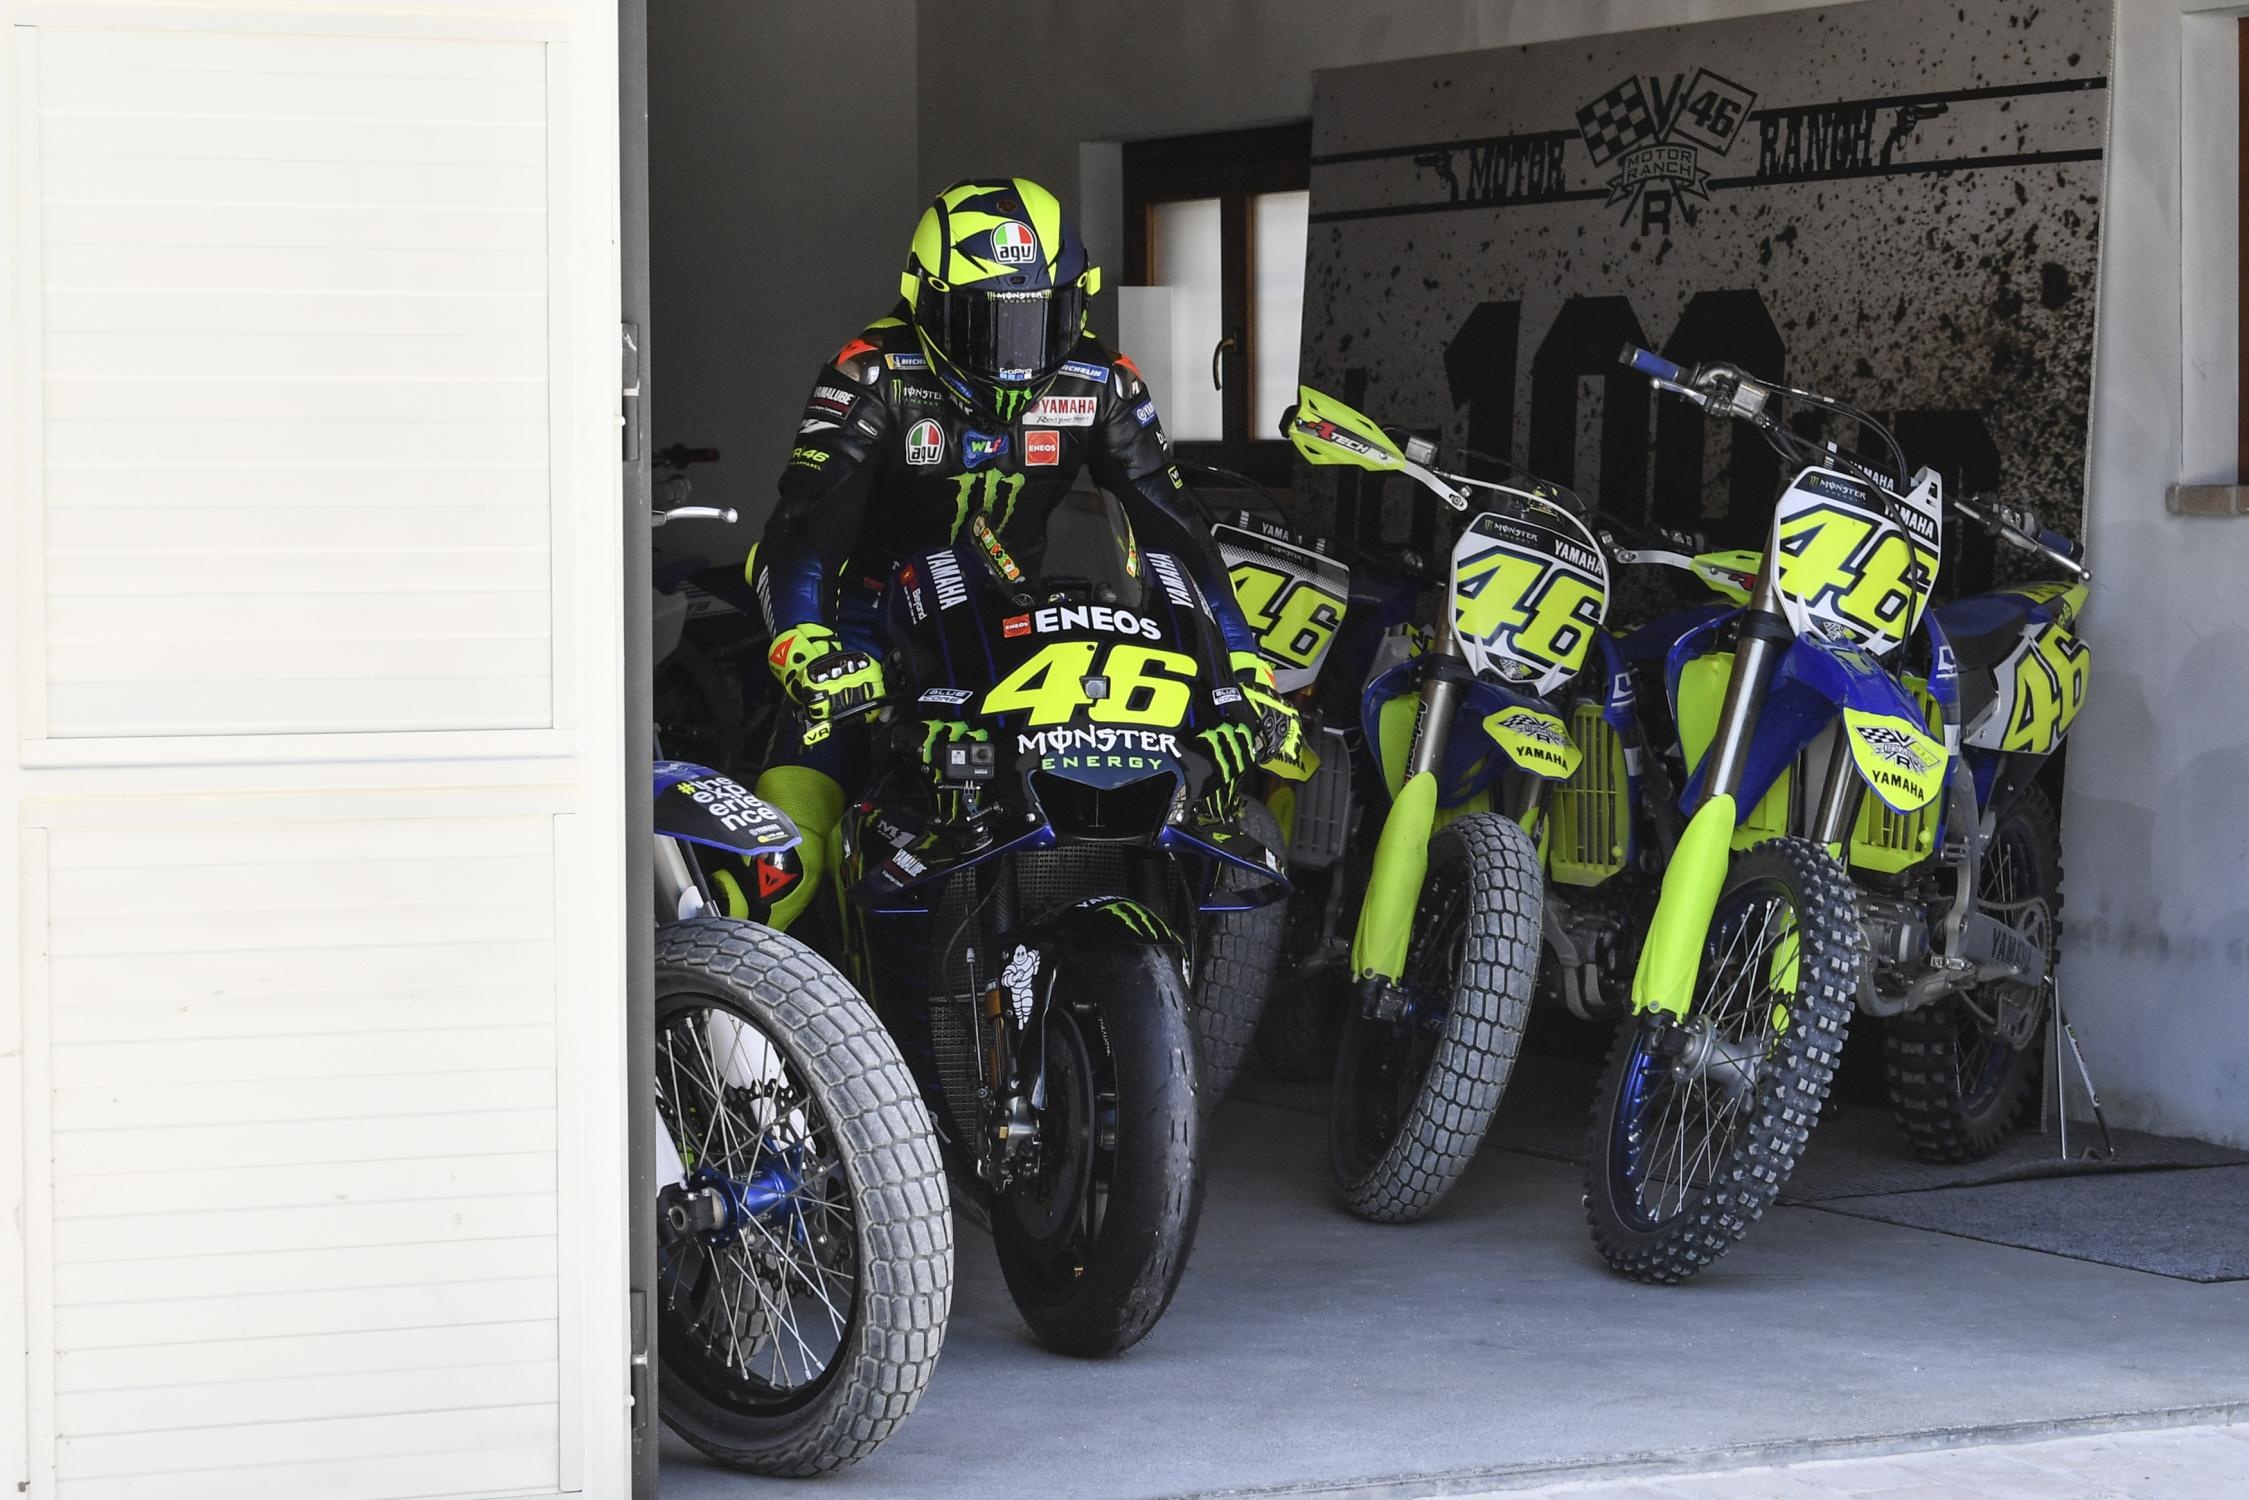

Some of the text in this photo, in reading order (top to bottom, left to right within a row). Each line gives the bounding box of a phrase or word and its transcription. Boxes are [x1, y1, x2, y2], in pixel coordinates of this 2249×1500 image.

[1687, 90, 1742, 138] 46
[1757, 107, 1876, 175] RANCH
[1466, 142, 1566, 200] MOTOR
[1627, 149, 1692, 168] MOTOR
[1627, 162, 1692, 181] RANCH
[1060, 364, 1103, 378] ICHELIN
[1042, 399, 1095, 414] YAMAHA
[1028, 444, 1057, 453] ENEOS
[1820, 479, 1867, 500] MONSTER
[1494, 523, 1539, 541] MONSTER
[926, 550, 968, 611] YAMAHA
[1146, 552, 1195, 609] YAMAHA
[1778, 509, 1939, 640] 46
[1004, 605, 1162, 640] ENEOS ENEOS
[1229, 566, 1348, 668] 46
[1456, 553, 1605, 672] 46
[980, 641, 1198, 728] 46
[1215, 689, 1237, 697] BLUE
[2001, 624, 2090, 753] 46
[1017, 724, 1182, 758] MONSTER
[1042, 755, 1163, 771] ENERGY
[1516, 746, 1569, 771] YAMAHA
[1872, 769, 1925, 801] YAMAHA
